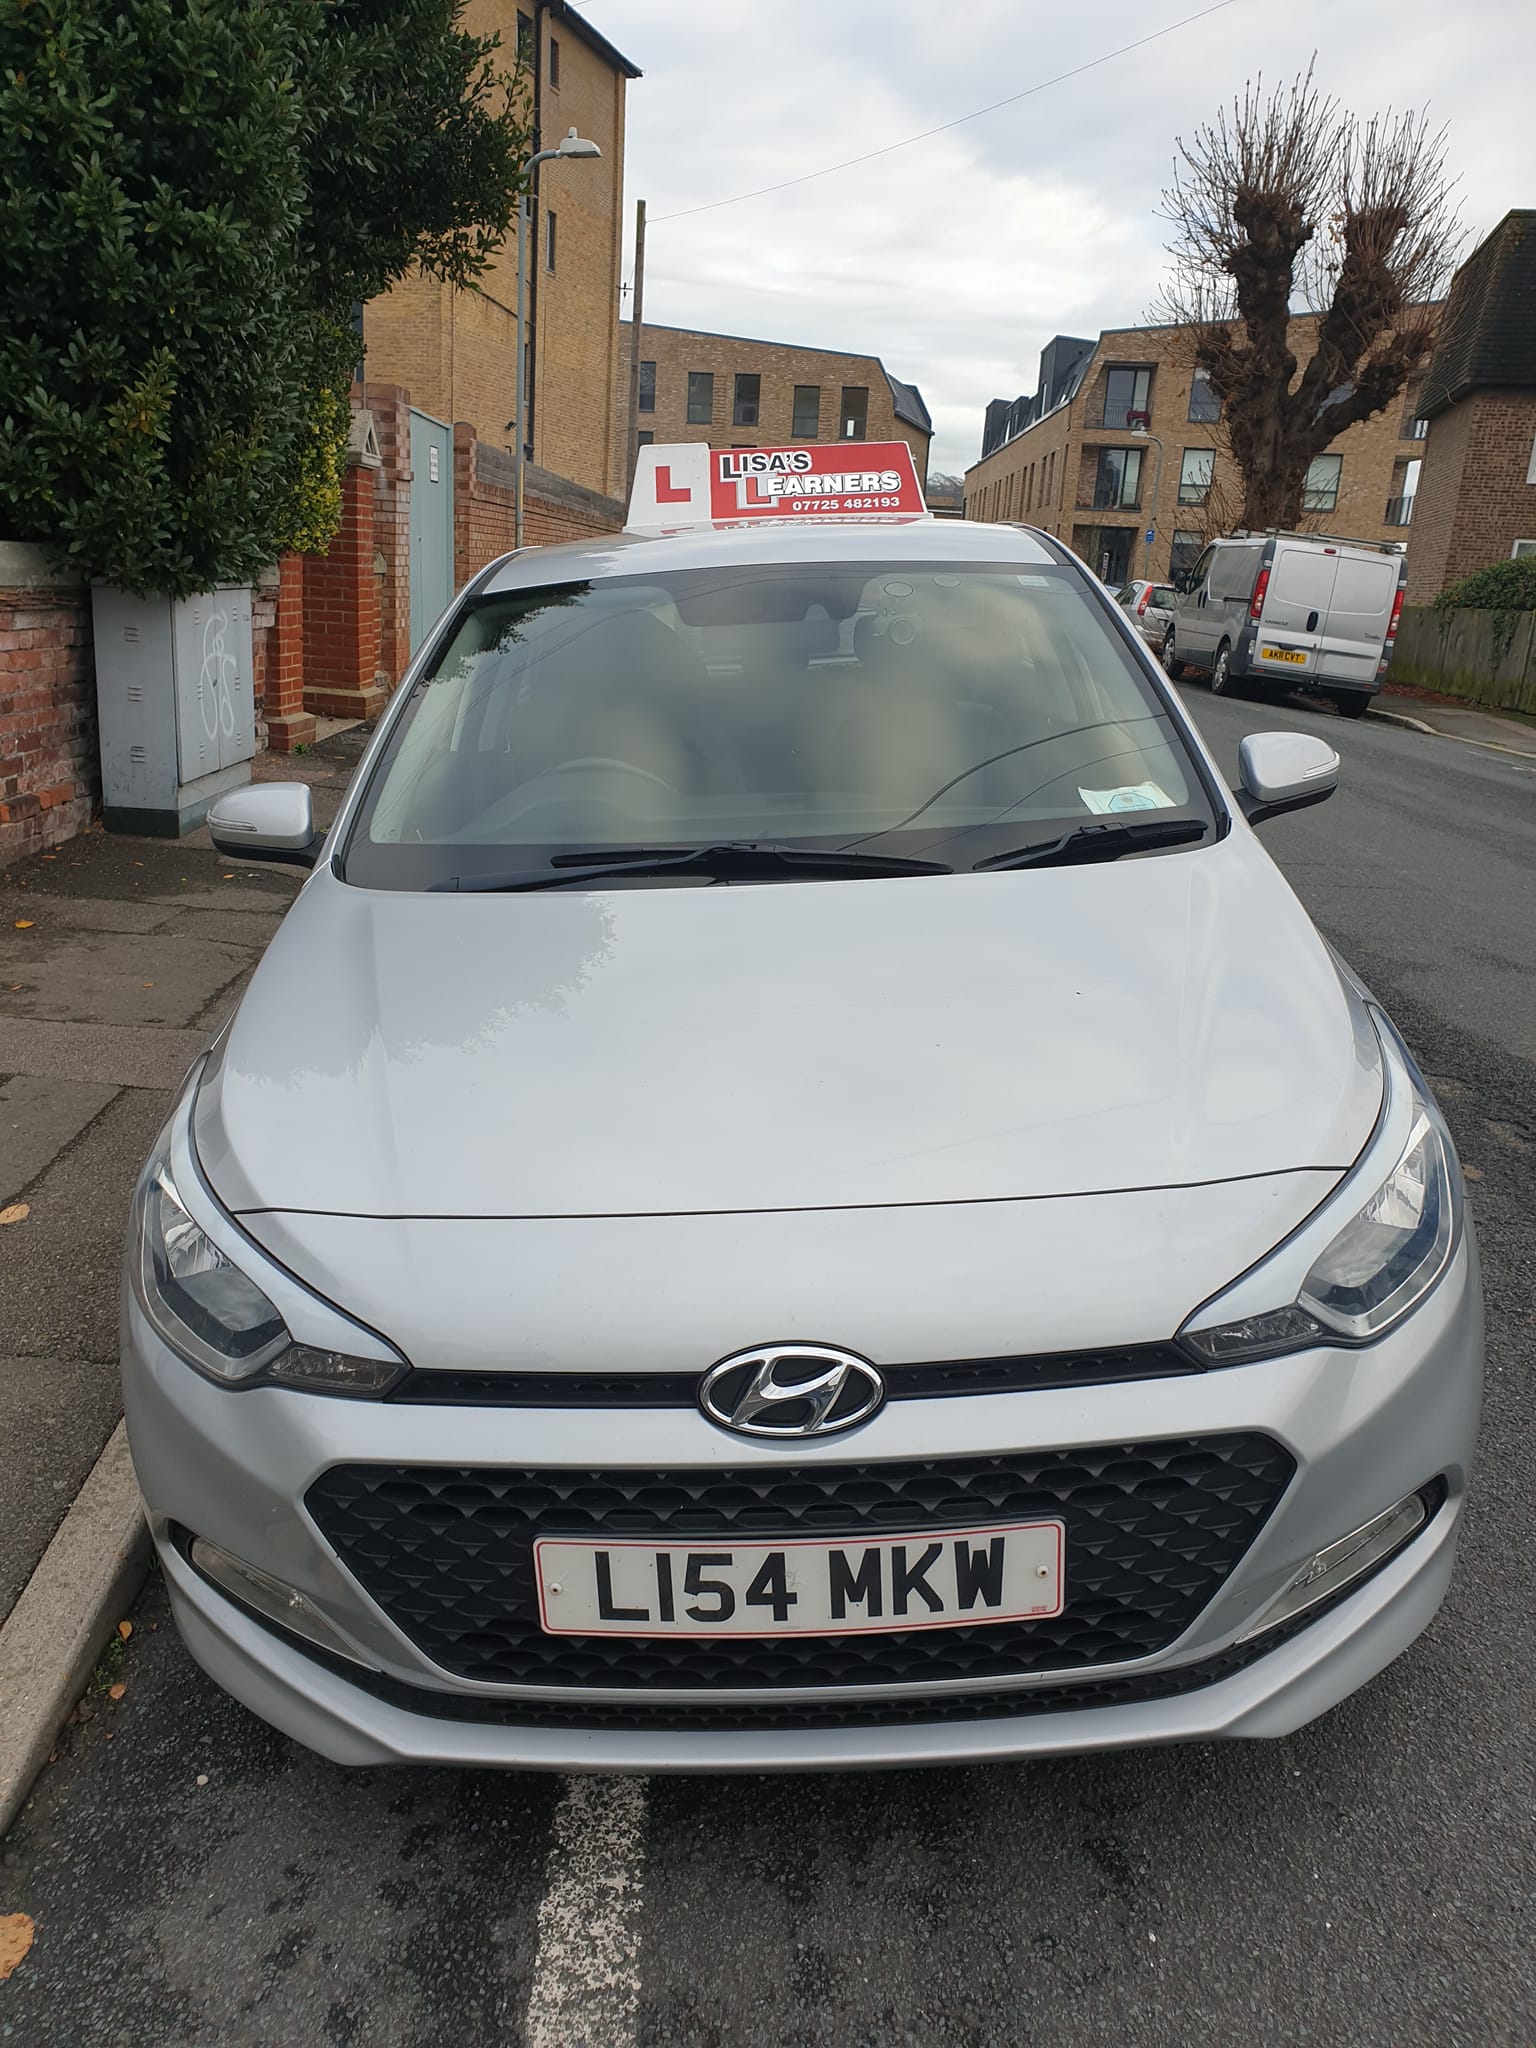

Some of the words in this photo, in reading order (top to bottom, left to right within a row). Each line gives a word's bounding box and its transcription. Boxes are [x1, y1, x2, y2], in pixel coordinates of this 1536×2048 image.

[722, 453, 810, 479] LISA'S
[655, 466, 691, 503] L
[738, 472, 901, 507] LEARNERS
[792, 500, 839, 511] 07725
[843, 497, 900, 509] 482193
[829, 1537, 1006, 1619] MKW
